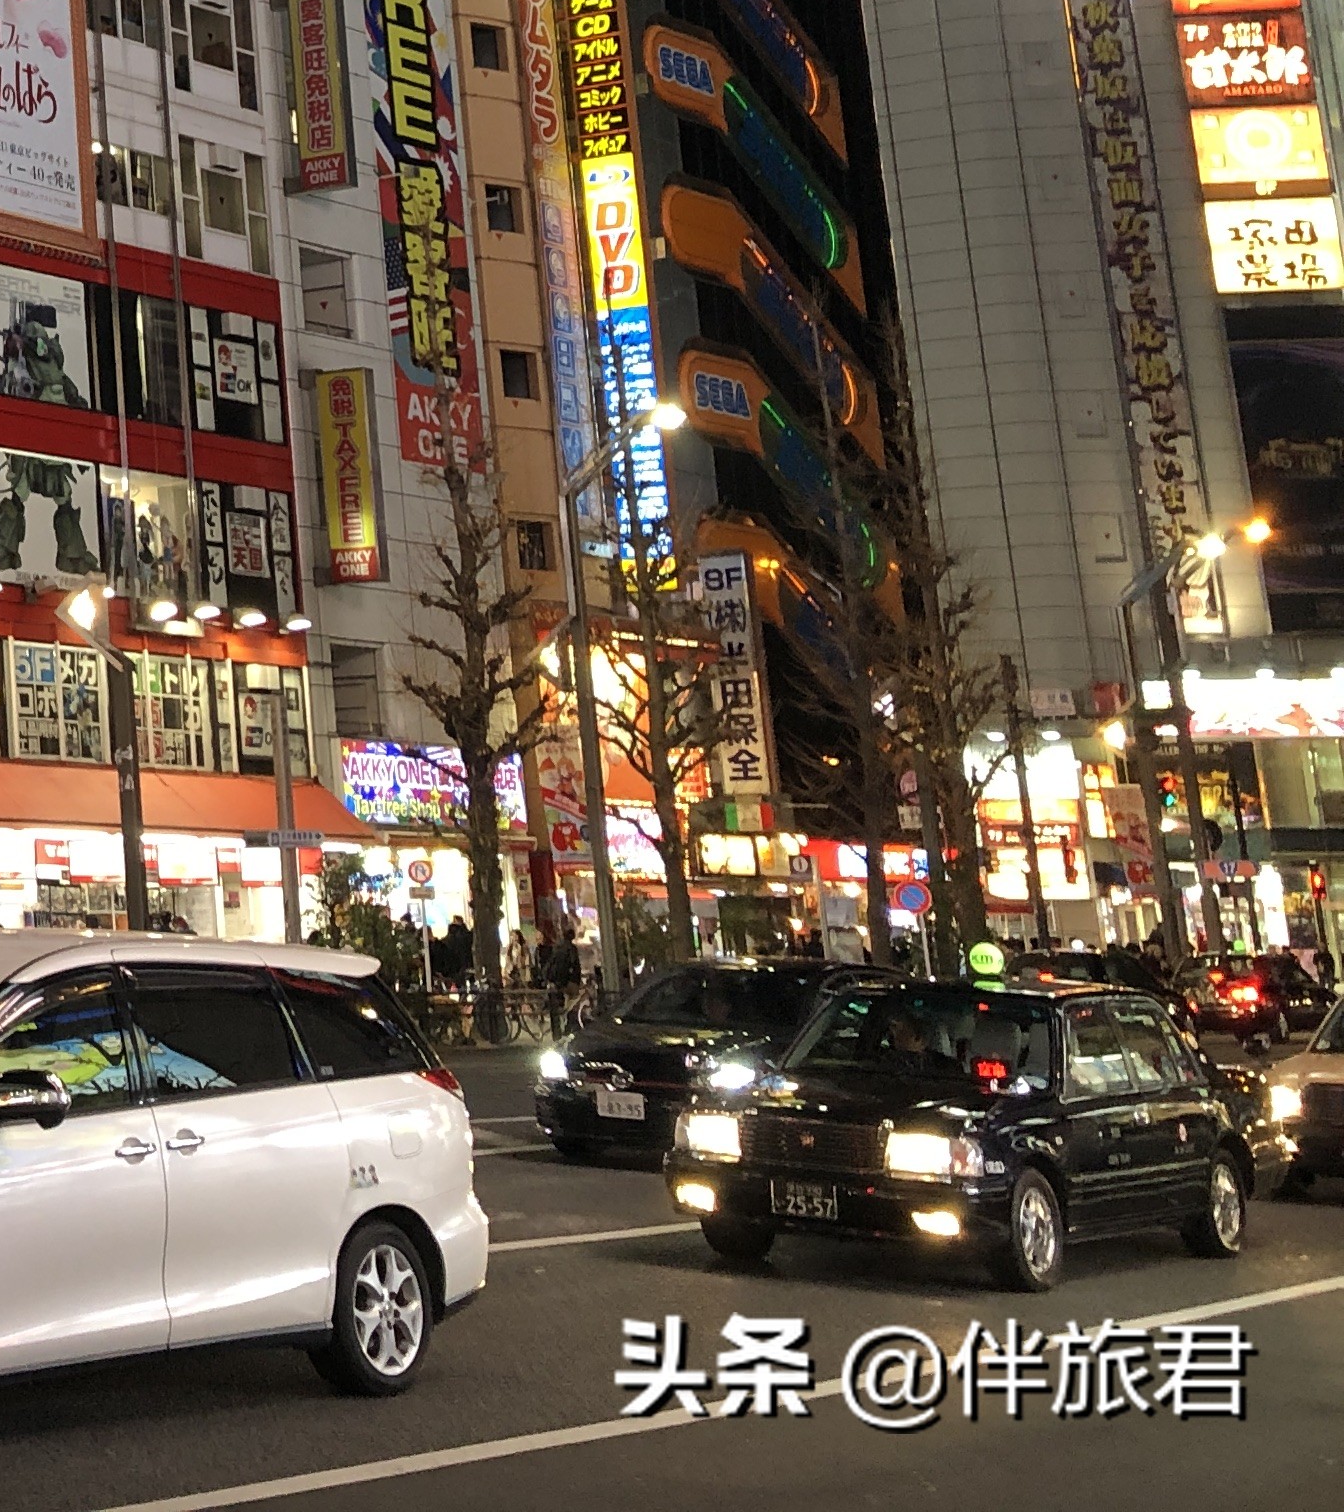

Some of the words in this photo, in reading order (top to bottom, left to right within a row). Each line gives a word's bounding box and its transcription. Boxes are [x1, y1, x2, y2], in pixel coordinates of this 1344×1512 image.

[576, 12, 611, 37] CD
[573, 38, 619, 61] アイドル
[575, 62, 622, 85] アニメ
[657, 44, 715, 95] SEGA
[578, 85, 622, 107] コミック
[1222, 85, 1284, 98] AMATARO
[583, 110, 624, 133] ホビー
[583, 133, 629, 156] フィギュア
[303, 155, 341, 173] AKKY
[309, 170, 340, 186] ONE
[594, 197, 641, 298] DVD
[330, 376, 356, 419] 免税
[694, 373, 752, 419] SEGA
[333, 422, 359, 474] TAX
[338, 475, 365, 545] FREE
[334, 549, 373, 565] AKKY
[339, 563, 371, 578] ONE
[703, 566, 742, 591] 8F
[15, 648, 56, 683] 5F
[350, 755, 394, 782] AKKY
[397, 759, 432, 787] ONE
